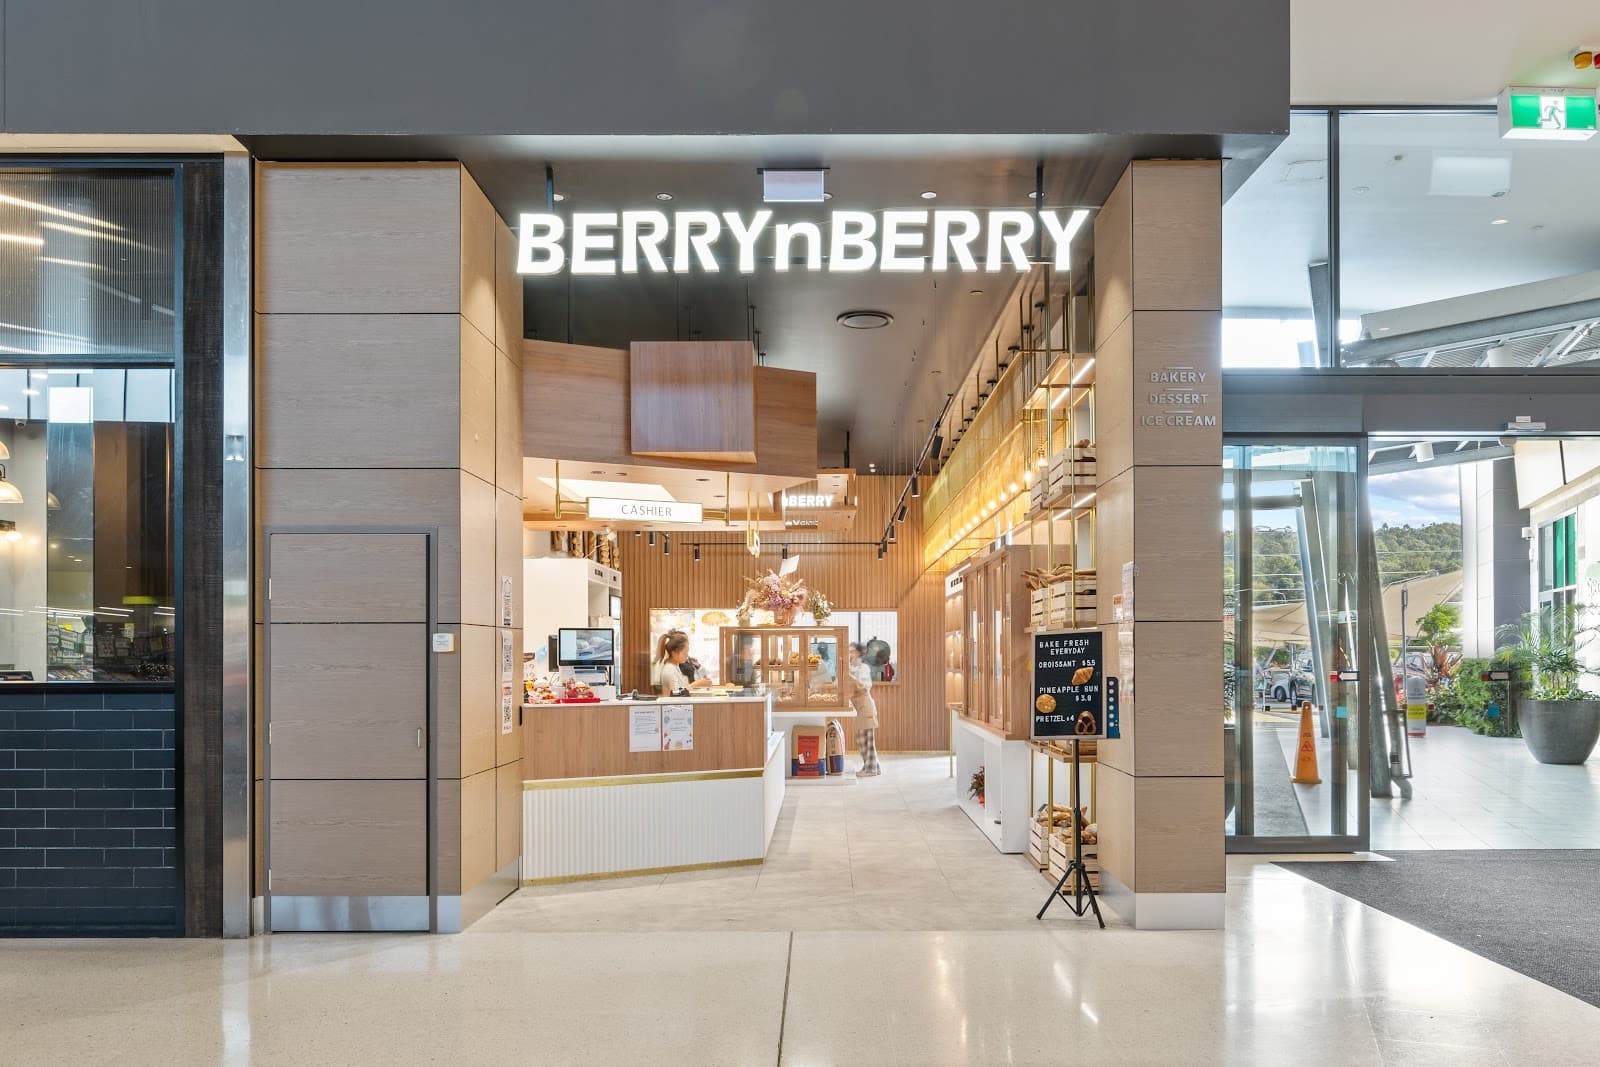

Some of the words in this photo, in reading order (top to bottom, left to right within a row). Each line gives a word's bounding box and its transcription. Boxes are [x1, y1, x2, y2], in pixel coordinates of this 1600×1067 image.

[516, 209, 1090, 275] BERRYnBERRY
[1150, 371, 1207, 383] BAKERY
[1150, 393, 1209, 404] DESSERT
[1141, 415, 1164, 426] ICE
[1166, 415, 1217, 426] CREAM
[621, 504, 672, 517] CASHIER
[1039, 640, 1060, 648] BAKE
[1063, 639, 1089, 647] FRESH
[1050, 647, 1086, 656] EVERYDAY
[1038, 660, 1076, 668] CROISSANT
[1039, 686, 1080, 694] PINEAPPLE
